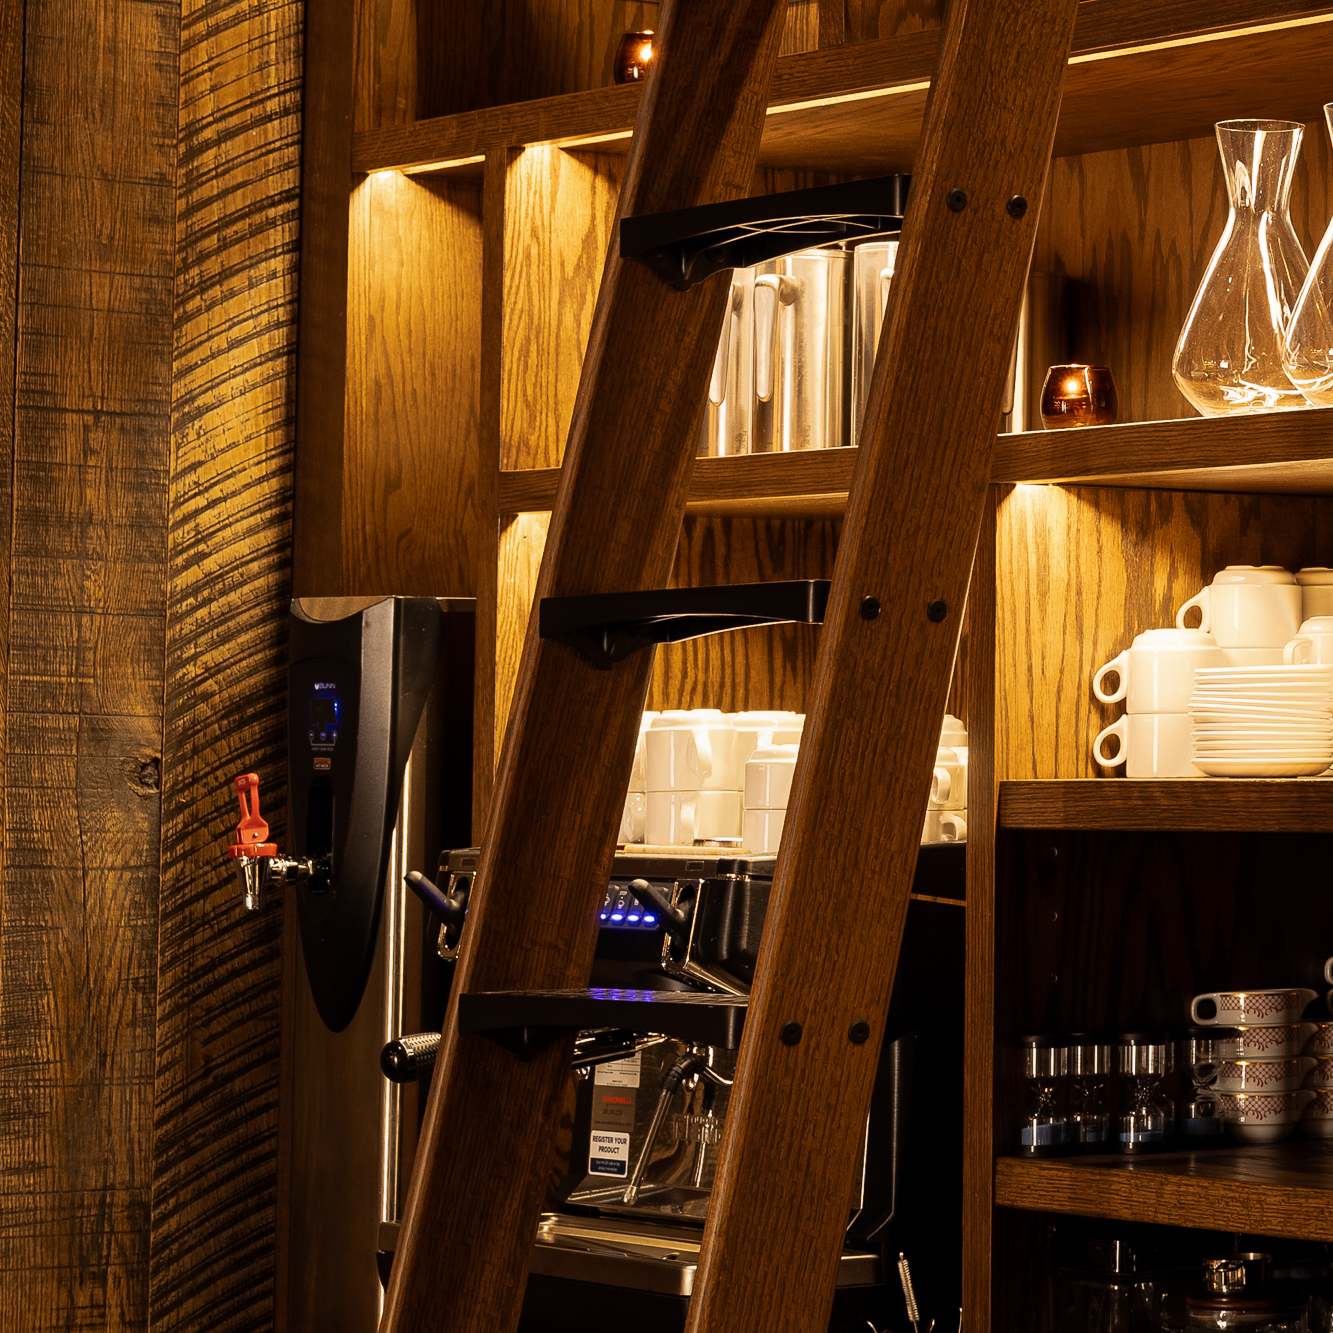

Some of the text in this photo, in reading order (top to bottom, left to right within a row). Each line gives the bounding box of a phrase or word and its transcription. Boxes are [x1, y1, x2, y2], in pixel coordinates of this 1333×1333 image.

[592, 1135, 627, 1145] REGISTER YOUR
[598, 1145, 620, 1154] PRODUCT
